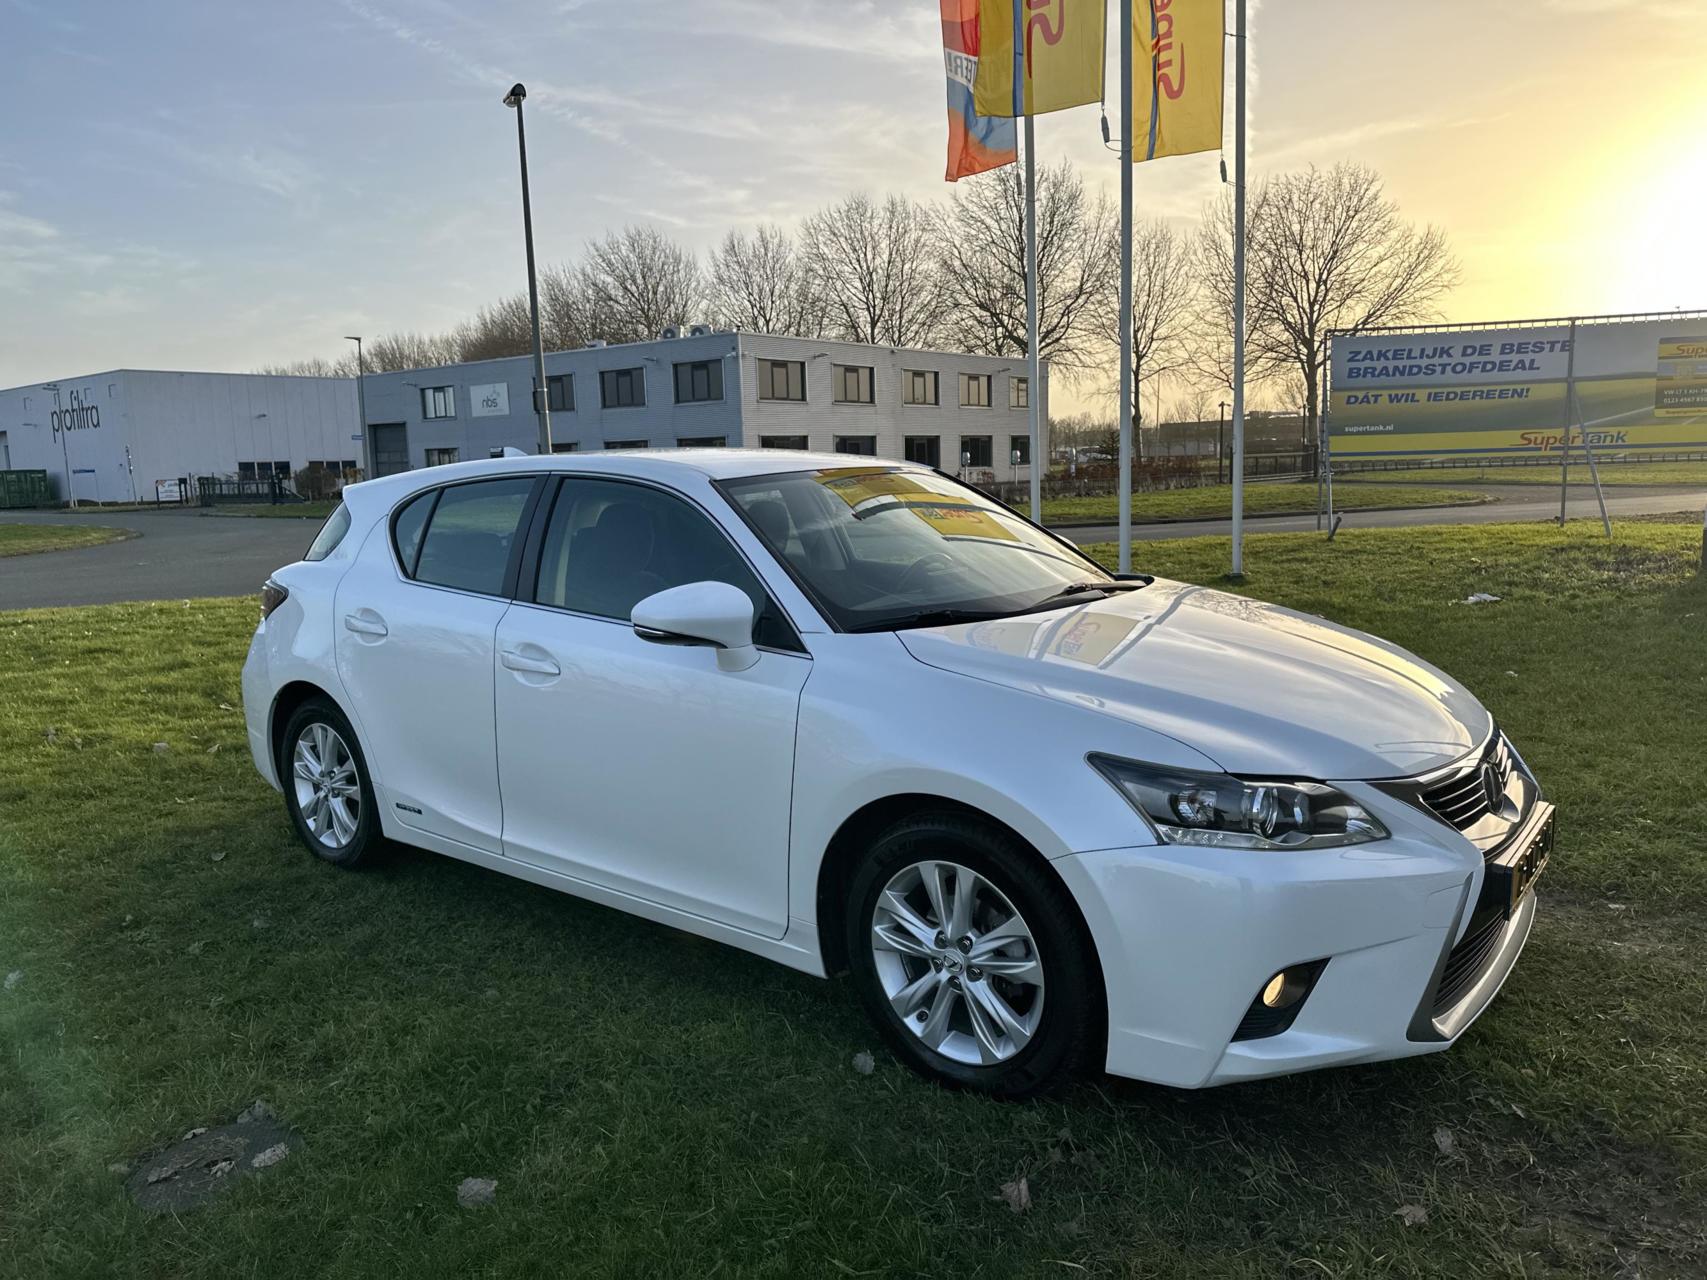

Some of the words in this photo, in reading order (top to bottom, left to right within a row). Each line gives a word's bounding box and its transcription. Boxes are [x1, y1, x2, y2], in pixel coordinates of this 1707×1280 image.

[1347, 346, 1454, 363] ZAKELIJK
[1461, 344, 1493, 358] DE
[1498, 339, 1574, 356] BESTE
[1676, 344, 1707, 358] Sup
[1347, 359, 1541, 379] BRANDSTOFDEAL
[481, 395, 498, 408] nbs
[1345, 391, 1383, 405] DÁT
[1387, 391, 1420, 404] WIL
[1426, 387, 1531, 403] IEDEREEN!
[1344, 424, 1394, 433] supertank.nl
